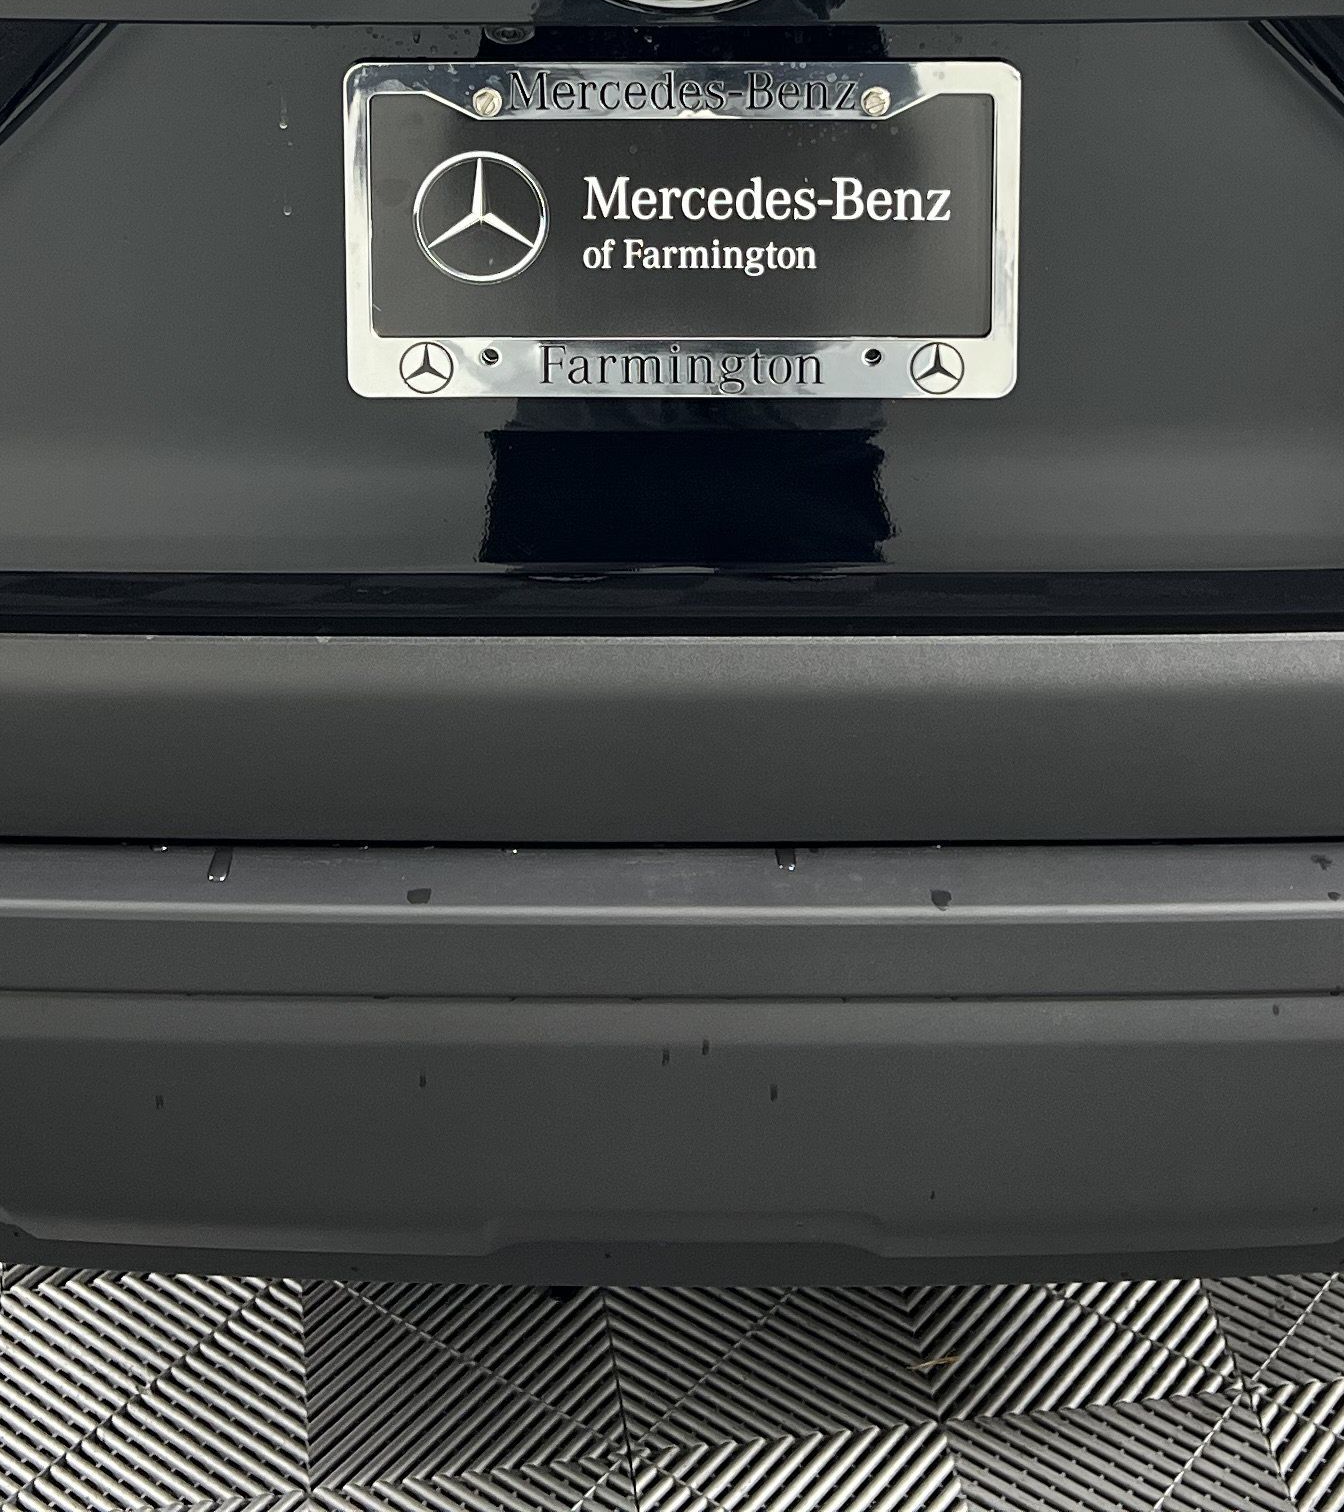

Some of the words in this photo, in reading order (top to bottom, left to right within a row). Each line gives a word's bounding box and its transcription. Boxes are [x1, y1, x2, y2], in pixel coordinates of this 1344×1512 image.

[510, 72, 857, 112] Mercedes-Benz
[584, 177, 952, 221] Mercedes-Benz
[583, 239, 617, 270] of
[624, 239, 817, 277] Farmington
[540, 345, 823, 393] Farmington
